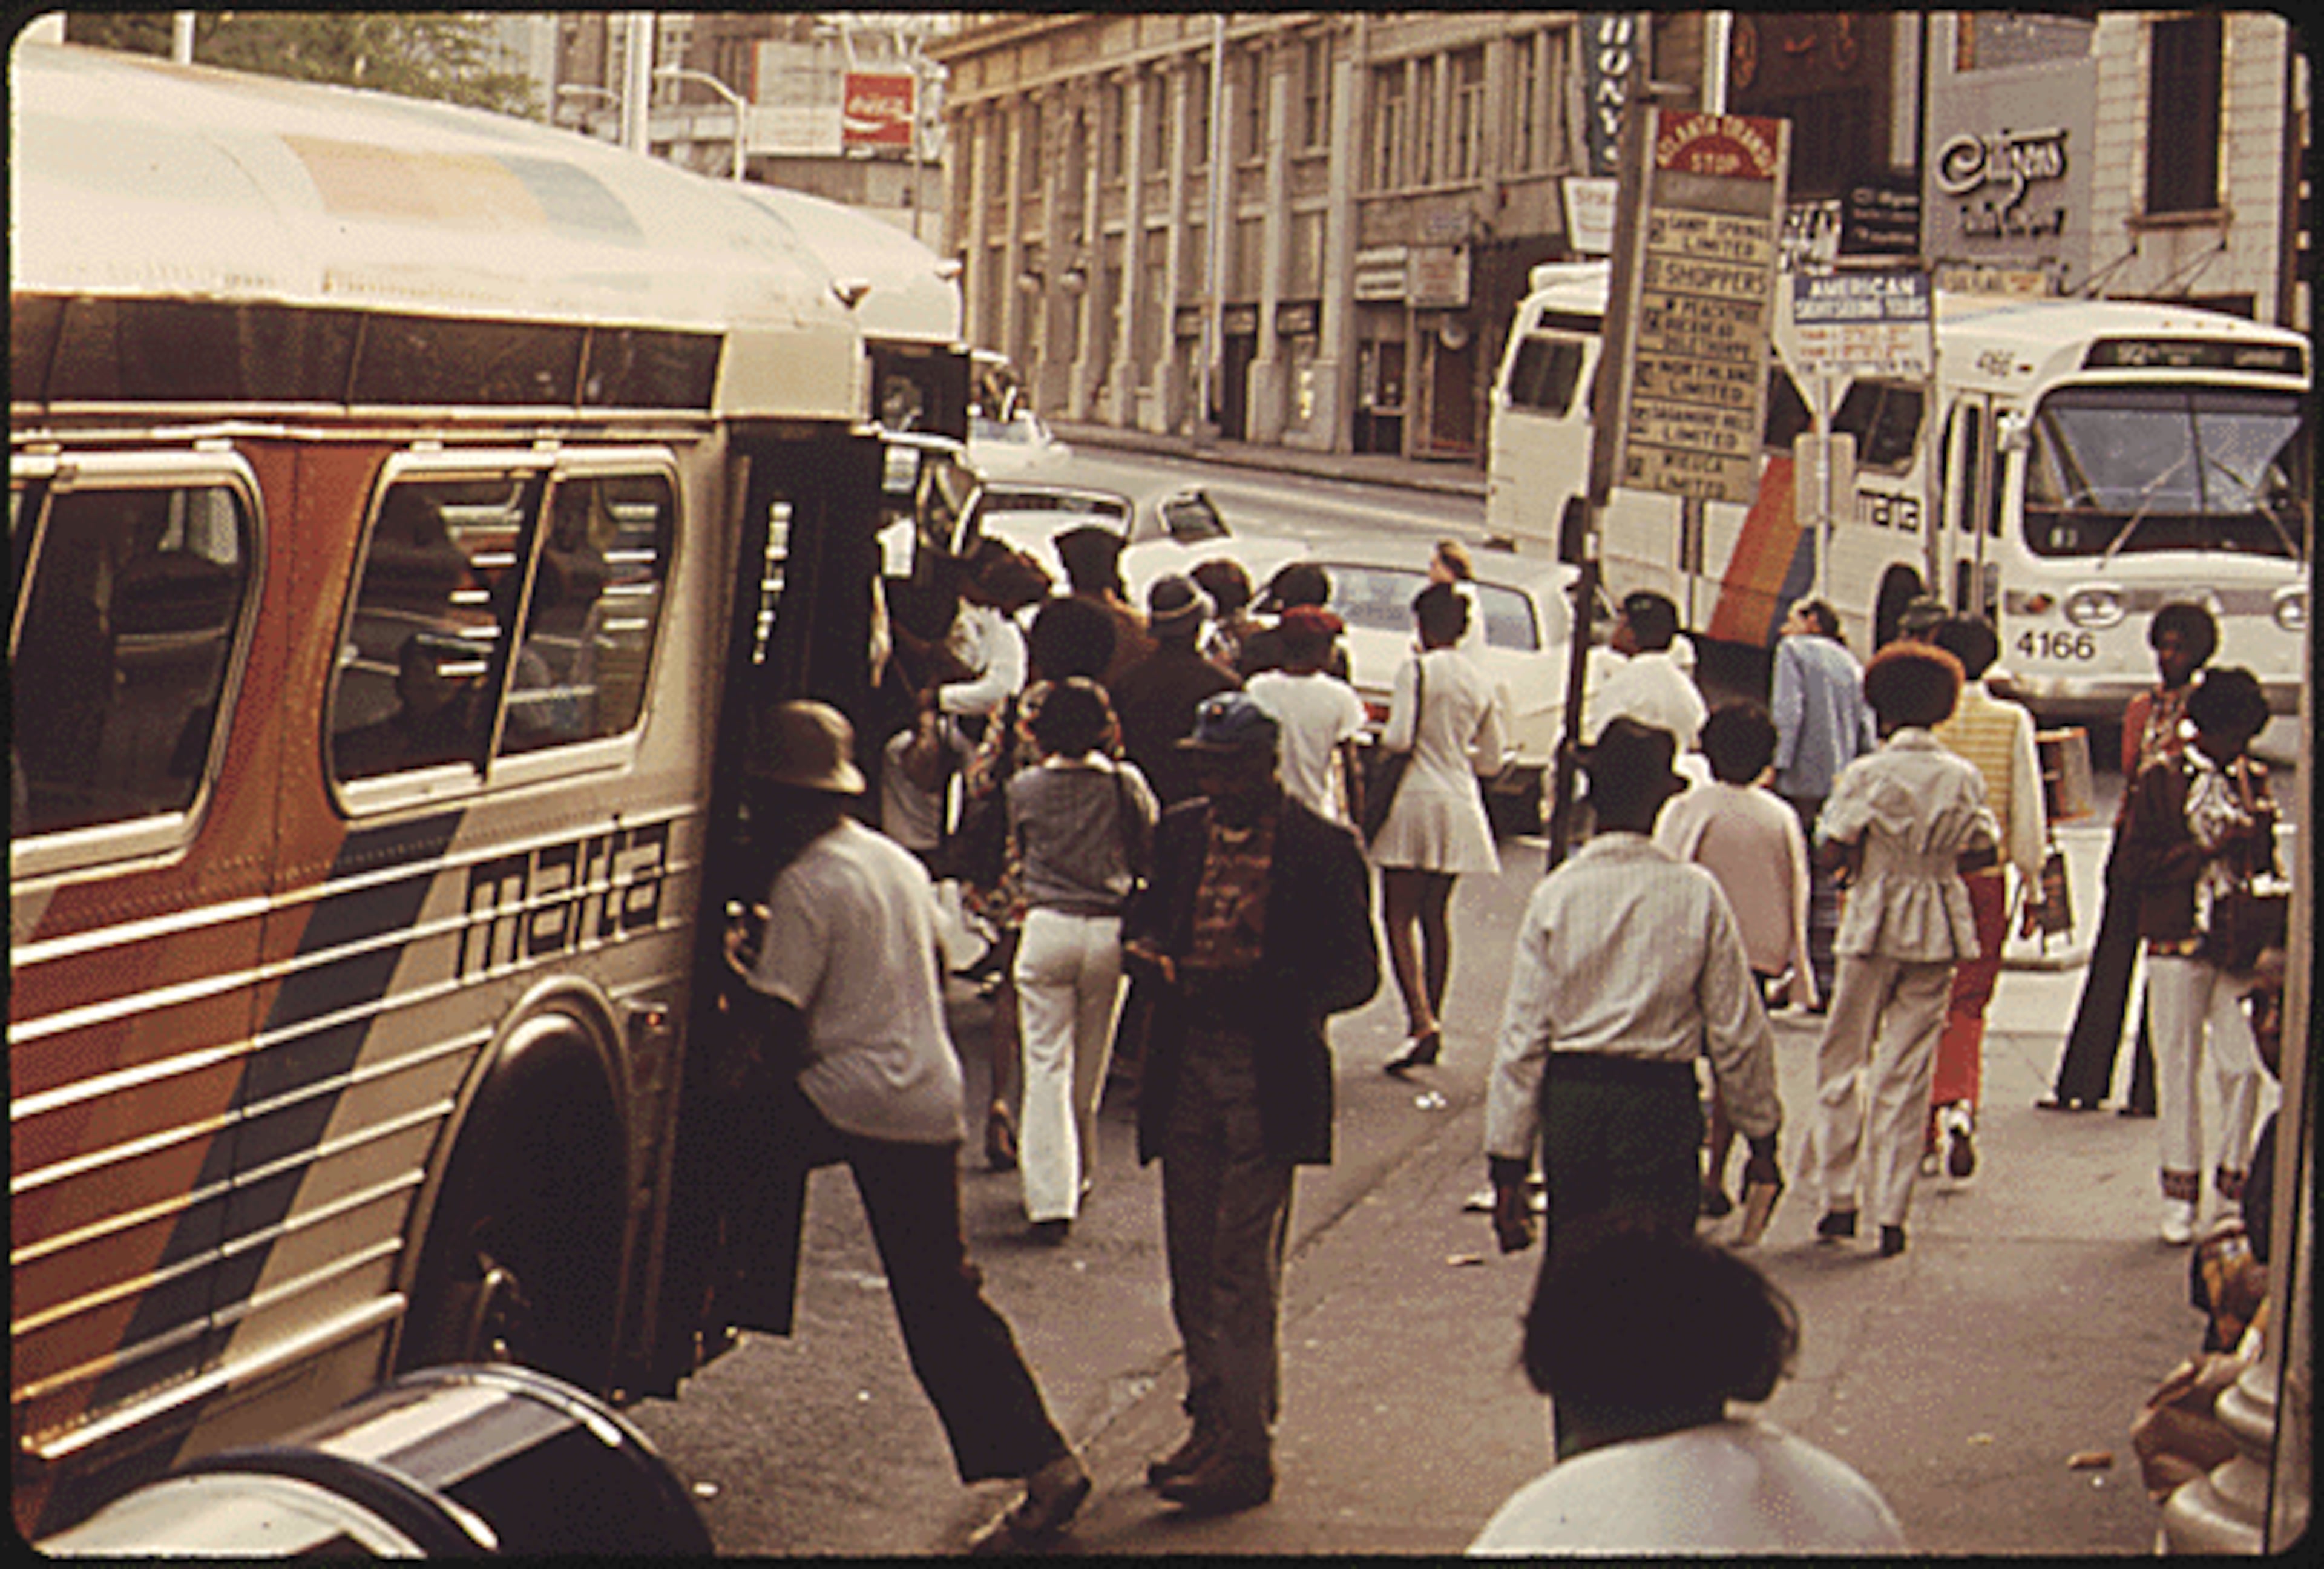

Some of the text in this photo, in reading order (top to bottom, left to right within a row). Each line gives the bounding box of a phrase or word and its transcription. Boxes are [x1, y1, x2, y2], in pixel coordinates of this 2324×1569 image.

[1690, 152, 1742, 173] STOP
[1666, 263, 1767, 293] SHOPPERS
[1810, 277, 1915, 297] AMERICAN
[2015, 631, 2096, 660] 4166
